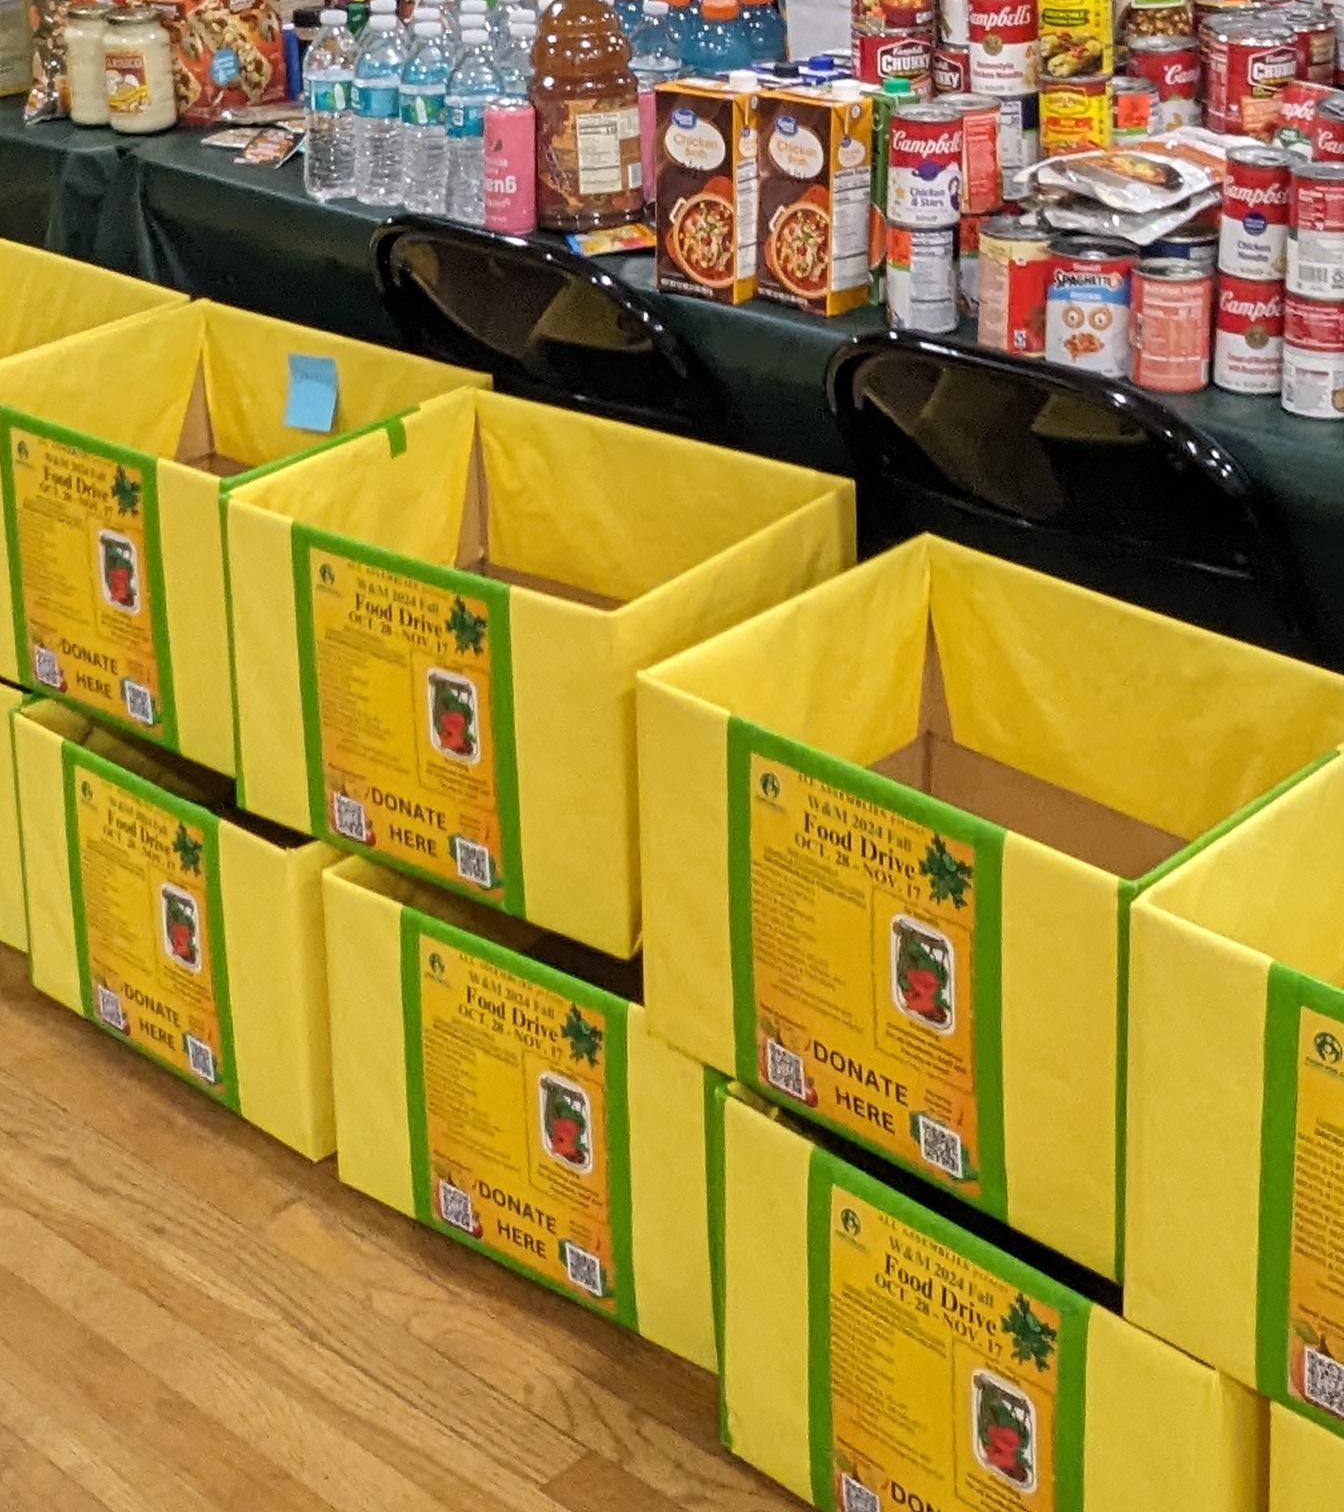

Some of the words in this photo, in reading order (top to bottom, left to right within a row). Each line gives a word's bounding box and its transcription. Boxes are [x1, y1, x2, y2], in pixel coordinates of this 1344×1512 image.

[673, 133, 719, 150] Chicken
[777, 141, 819, 157] Chicken
[910, 186, 946, 199] Chicken
[919, 197, 945, 208] Stars
[1236, 239, 1272, 253] Chicken
[43, 466, 72, 491] Food
[76, 476, 109, 504] Drive
[355, 592, 393, 623] Food
[399, 609, 443, 638] Drive
[61, 639, 120, 676] DONATE
[75, 670, 113, 701] HERE
[371, 786, 448, 832] DONATE
[807, 794, 849, 826] W&M
[852, 814, 884, 840] 2024
[887, 831, 913, 853] Fall
[107, 808, 137, 838] Food
[140, 826, 171, 857] Drive
[389, 823, 439, 860] HERE
[803, 811, 854, 852] Food
[860, 834, 916, 880] Drive
[835, 851, 850, 868] 28
[906, 884, 922, 900] 17
[124, 980, 183, 1030] DONATE
[466, 985, 507, 1021] Food
[511, 1007, 559, 1043] Drive
[138, 1016, 177, 1052] HERE
[550, 1046, 565, 1060] 17
[813, 1039, 909, 1108] DONATE
[835, 1086, 897, 1135] HERE
[477, 1180, 558, 1236] DONATE
[496, 1218, 548, 1260] HERE
[883, 1252, 934, 1301] Food
[941, 1286, 998, 1338] Drive
[888, 1235, 932, 1272] W&M
[934, 1262, 965, 1291] 2024
[967, 1282, 995, 1309] Fall
[914, 1296, 931, 1315] 28
[987, 1340, 1004, 1358] 17
